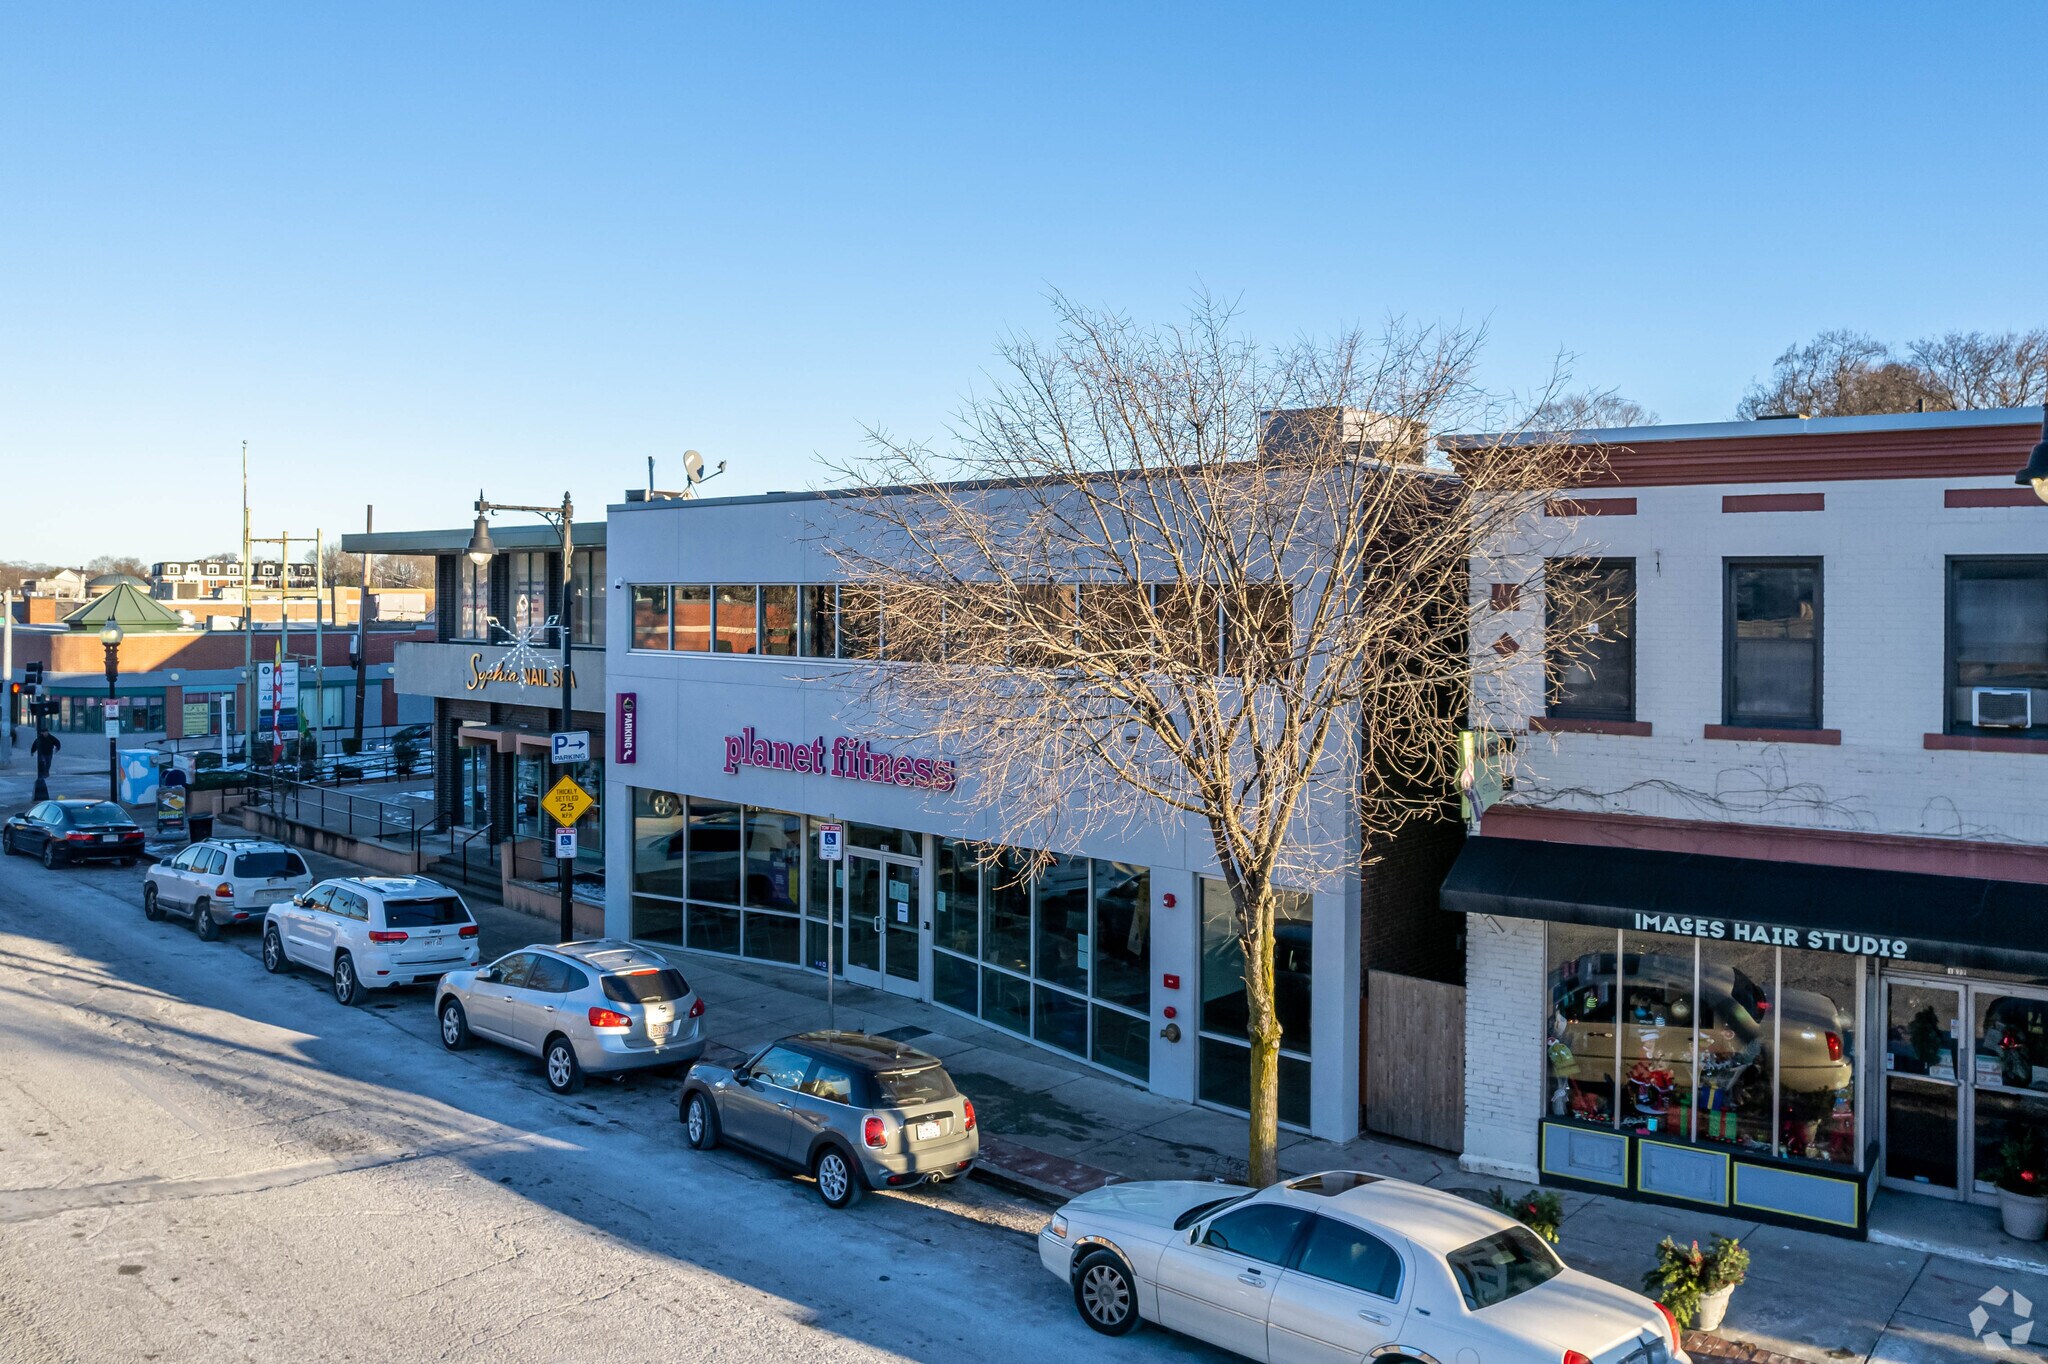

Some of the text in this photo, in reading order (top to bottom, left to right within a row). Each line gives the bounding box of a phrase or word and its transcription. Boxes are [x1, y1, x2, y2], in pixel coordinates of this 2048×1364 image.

[466, 653, 519, 690] Sophia
[524, 668, 550, 687] NAIL
[554, 735, 568, 755] P
[624, 713, 633, 748] PARKING
[554, 753, 586, 761] PARKING
[723, 727, 956, 792] planet fitness
[560, 803, 575, 812] 25
[1635, 913, 1908, 959] IMAGES HAIR STUDIO
